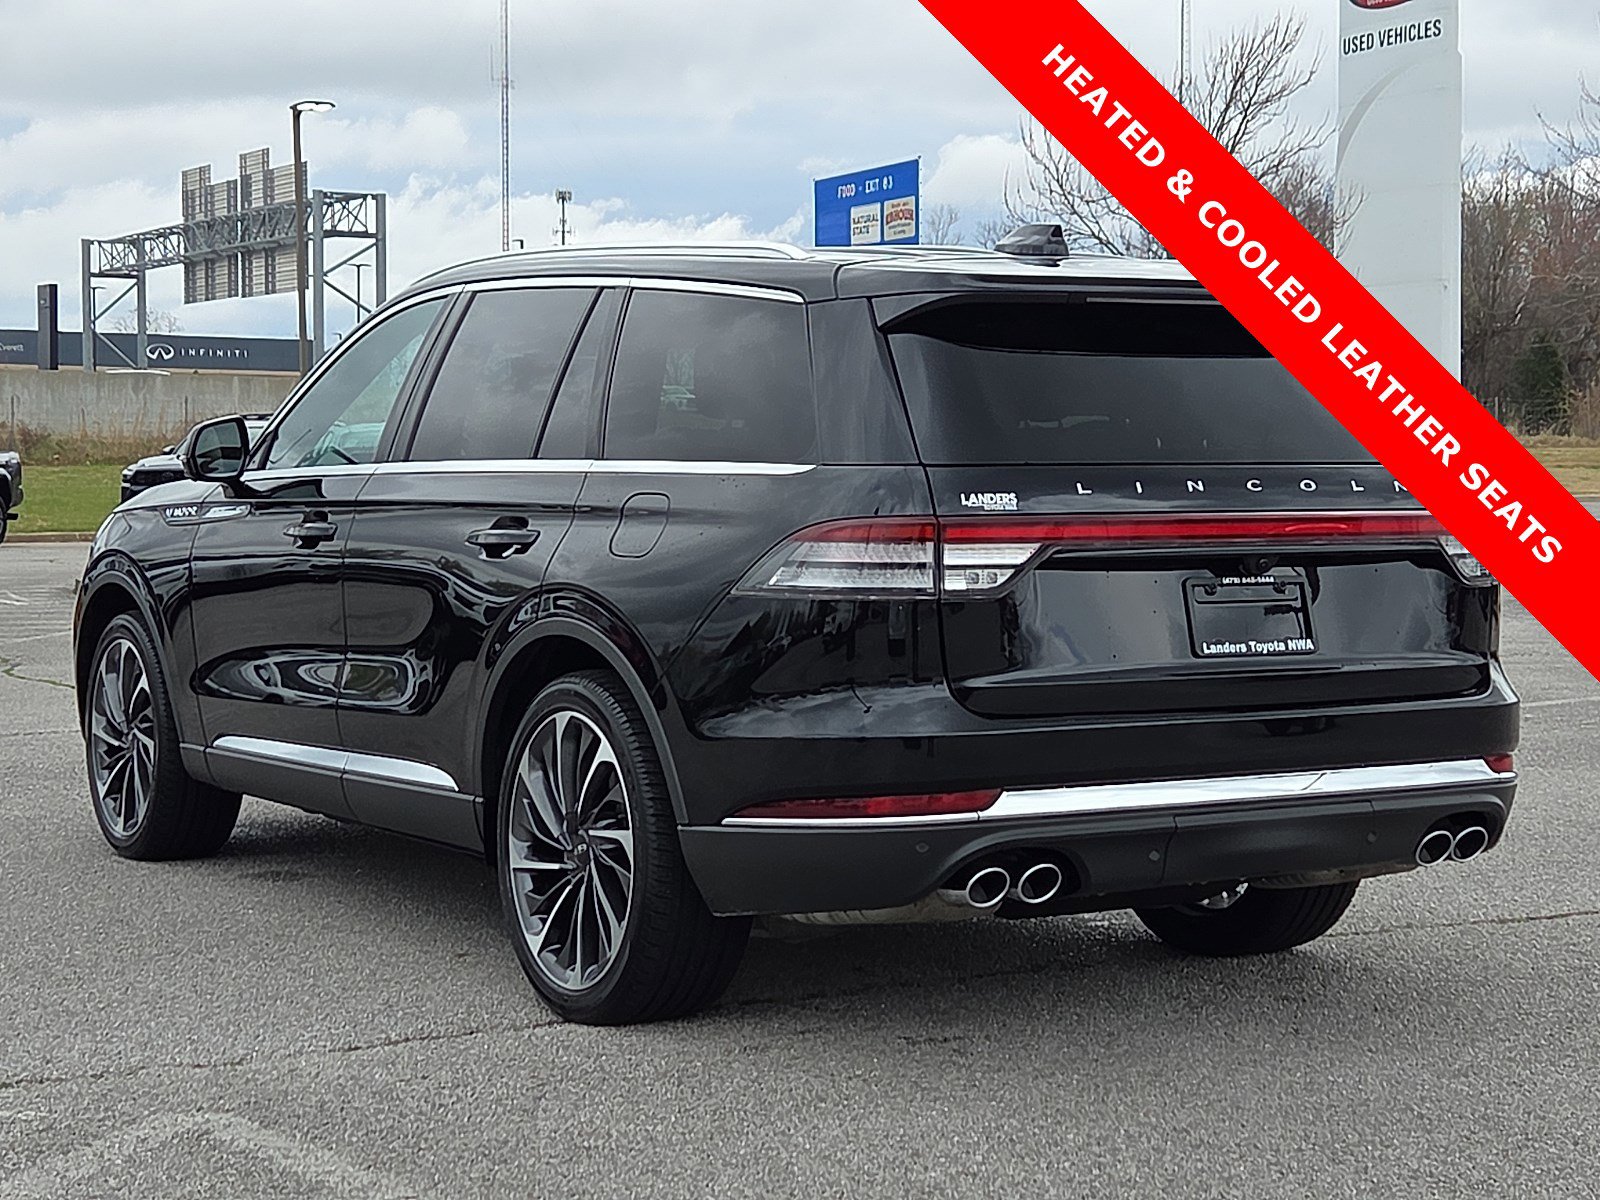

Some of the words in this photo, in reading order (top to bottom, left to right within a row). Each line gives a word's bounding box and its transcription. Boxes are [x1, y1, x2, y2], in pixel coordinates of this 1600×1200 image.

[1343, 33, 1374, 55] USED
[1378, 19, 1442, 47] VEHICLES
[837, 183, 856, 199] FOOD
[852, 213, 879, 225] NATURAL
[852, 225, 870, 237] STATE
[180, 348, 248, 358] INFINITI
[960, 492, 1017, 507] LANDERS
[1202, 641, 1247, 654] Landers
[1249, 640, 1285, 654] Toyota
[1287, 638, 1315, 651] NWA
